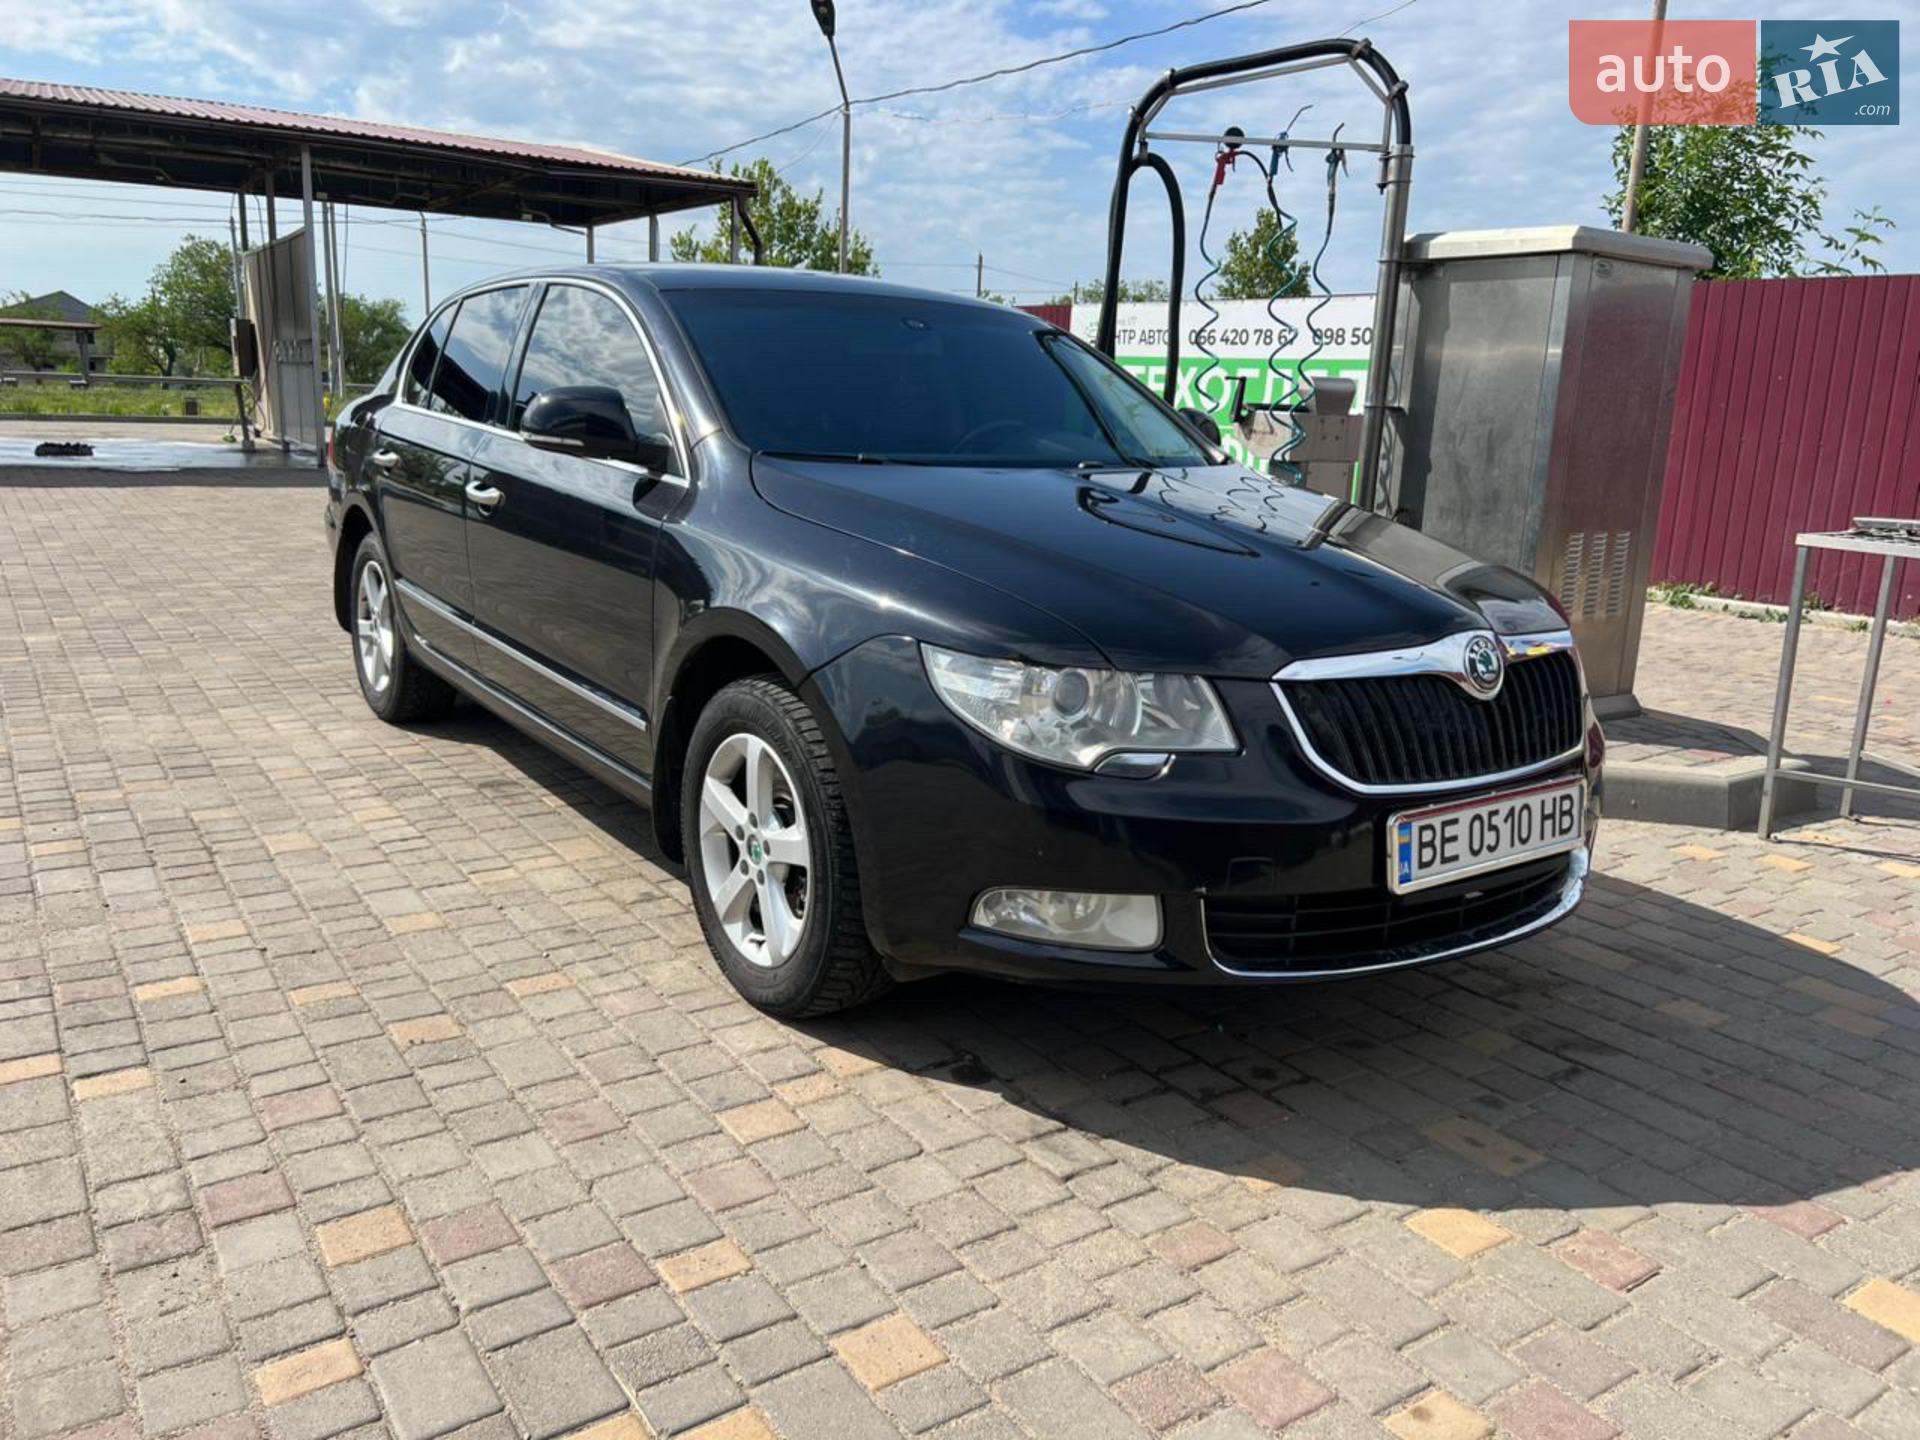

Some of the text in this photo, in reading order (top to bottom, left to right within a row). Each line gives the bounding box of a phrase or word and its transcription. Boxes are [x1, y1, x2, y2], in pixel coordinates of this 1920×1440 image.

[1219, 328, 1249, 346] 420
[1253, 328, 1274, 346] 78
[1312, 327, 1346, 346] 098
[1417, 793, 1575, 870] BE 0510 HB
